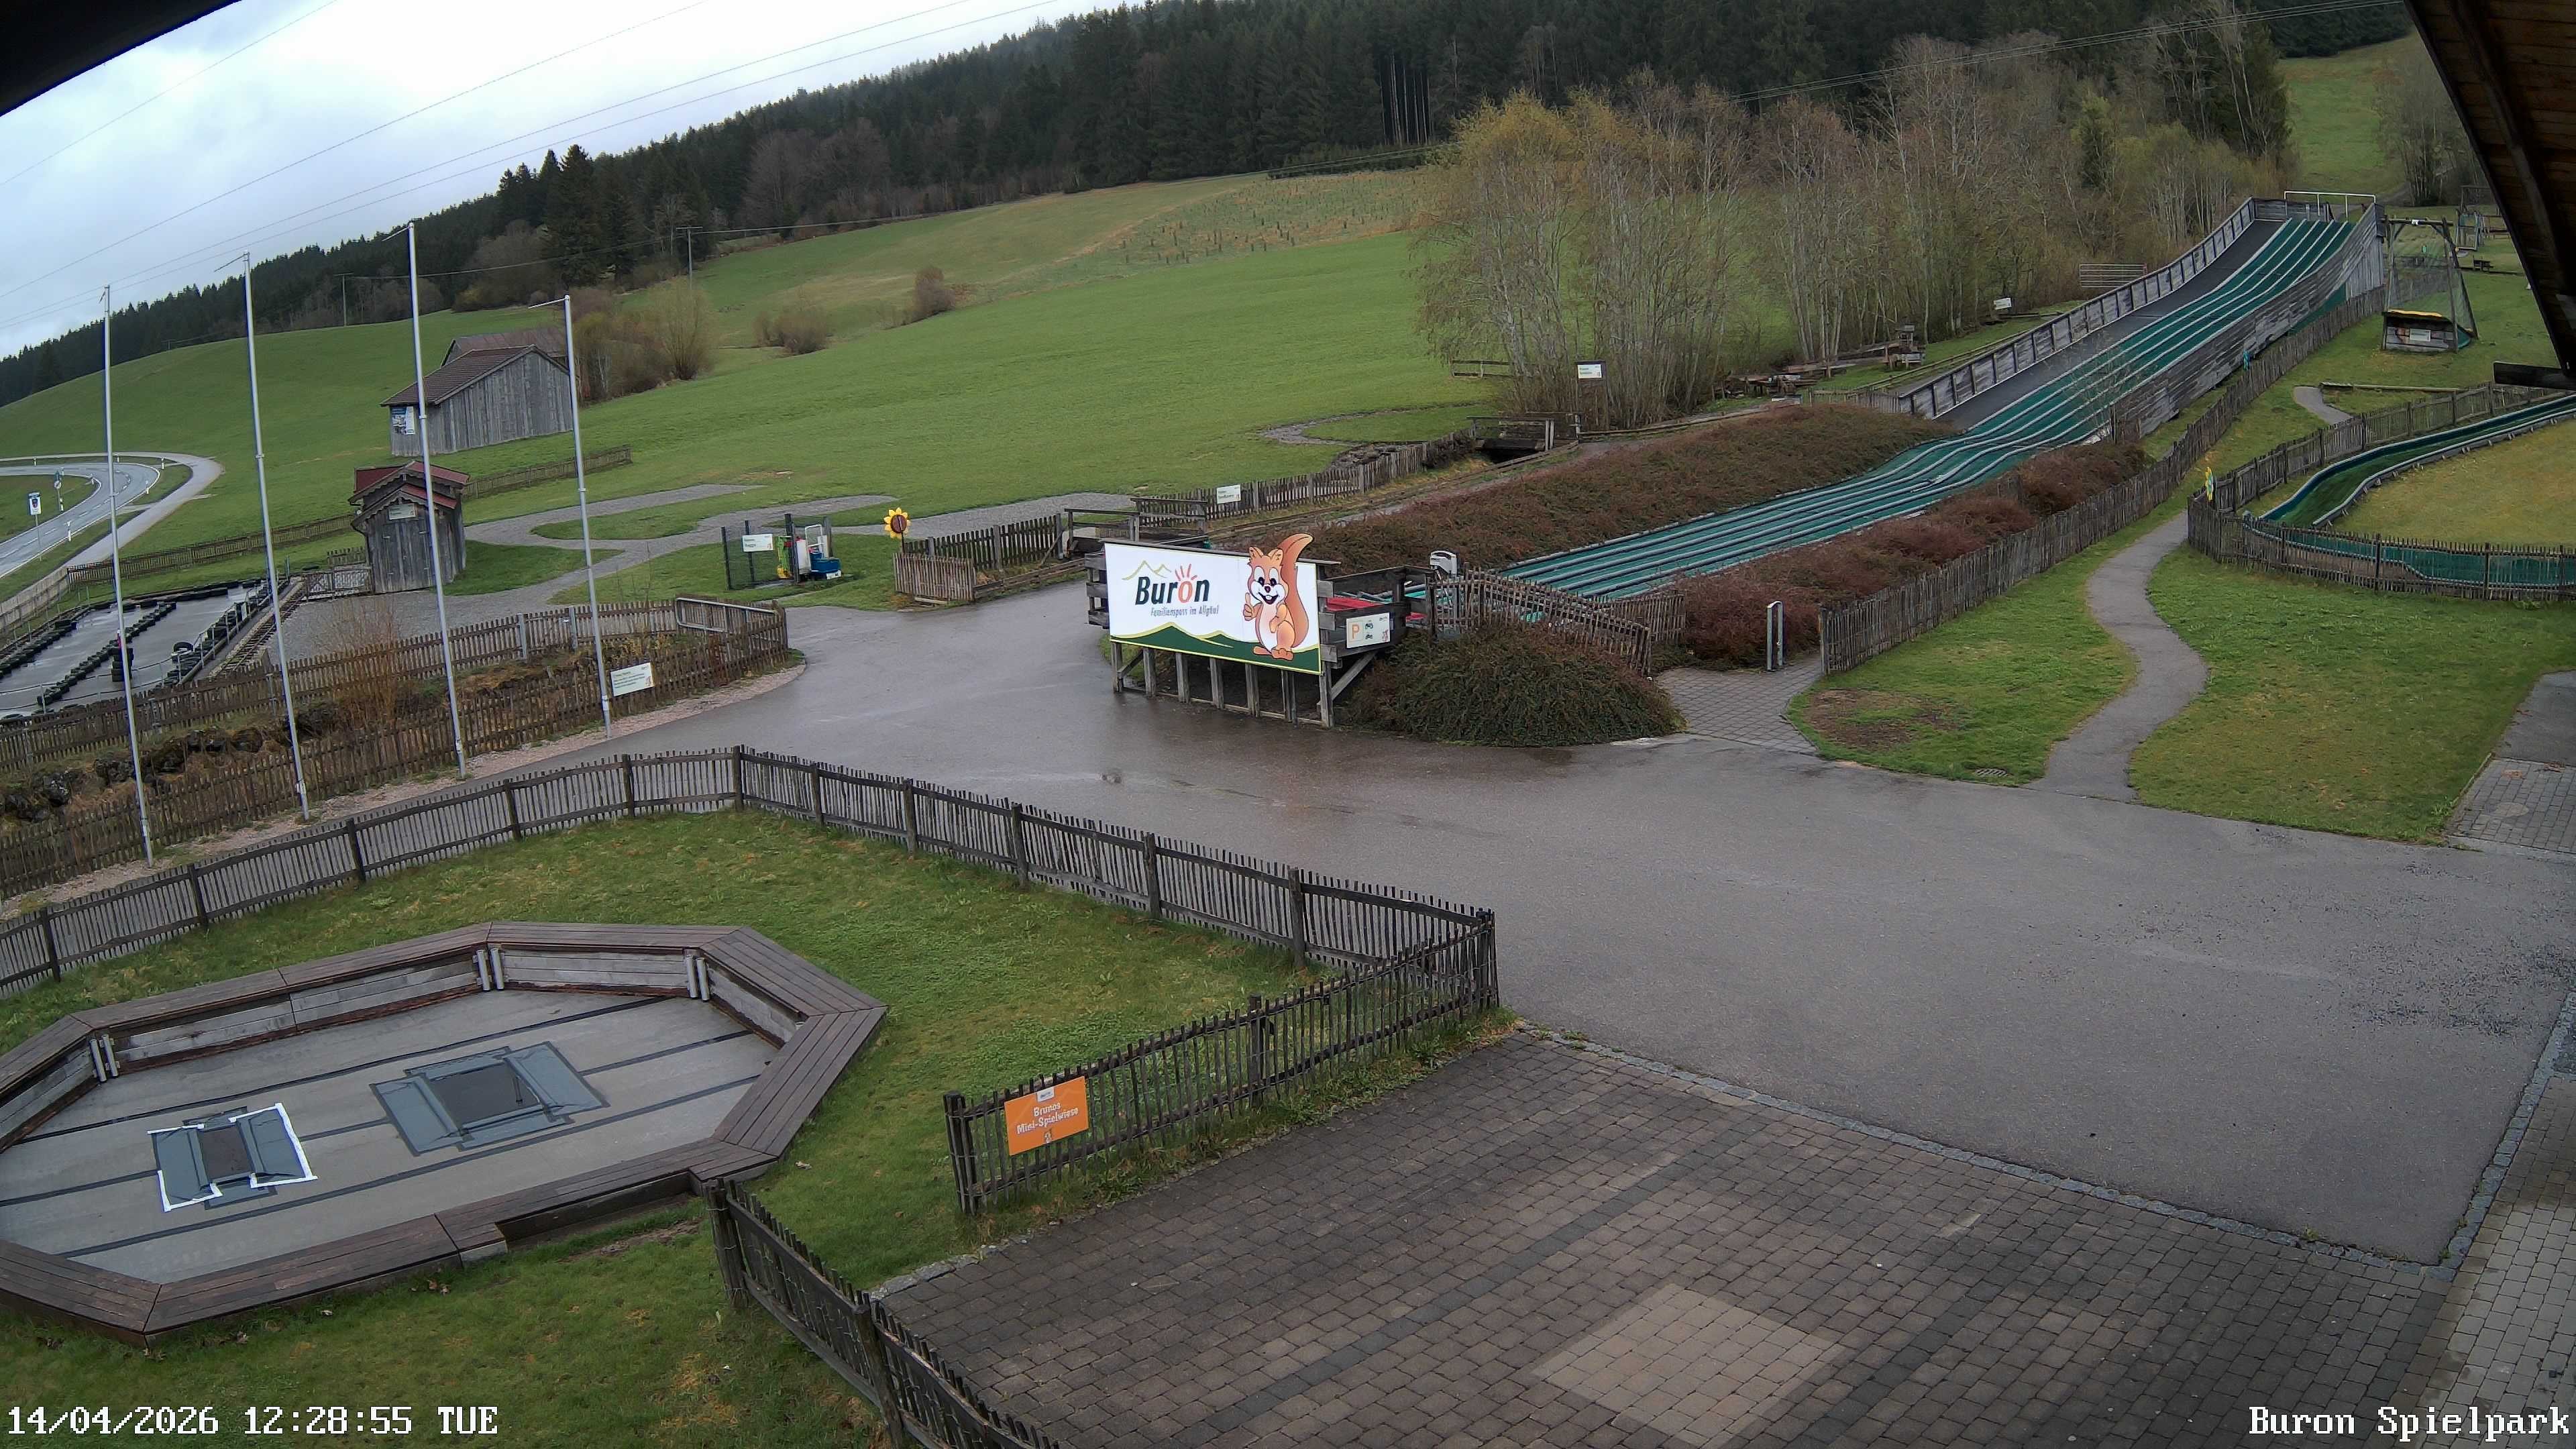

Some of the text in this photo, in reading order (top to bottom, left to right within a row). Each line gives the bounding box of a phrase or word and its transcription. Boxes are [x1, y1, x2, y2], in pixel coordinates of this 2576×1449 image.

[1135, 576, 1210, 605] Buron
[1189, 606, 1197, 615] im
[1352, 625, 1359, 639] P
